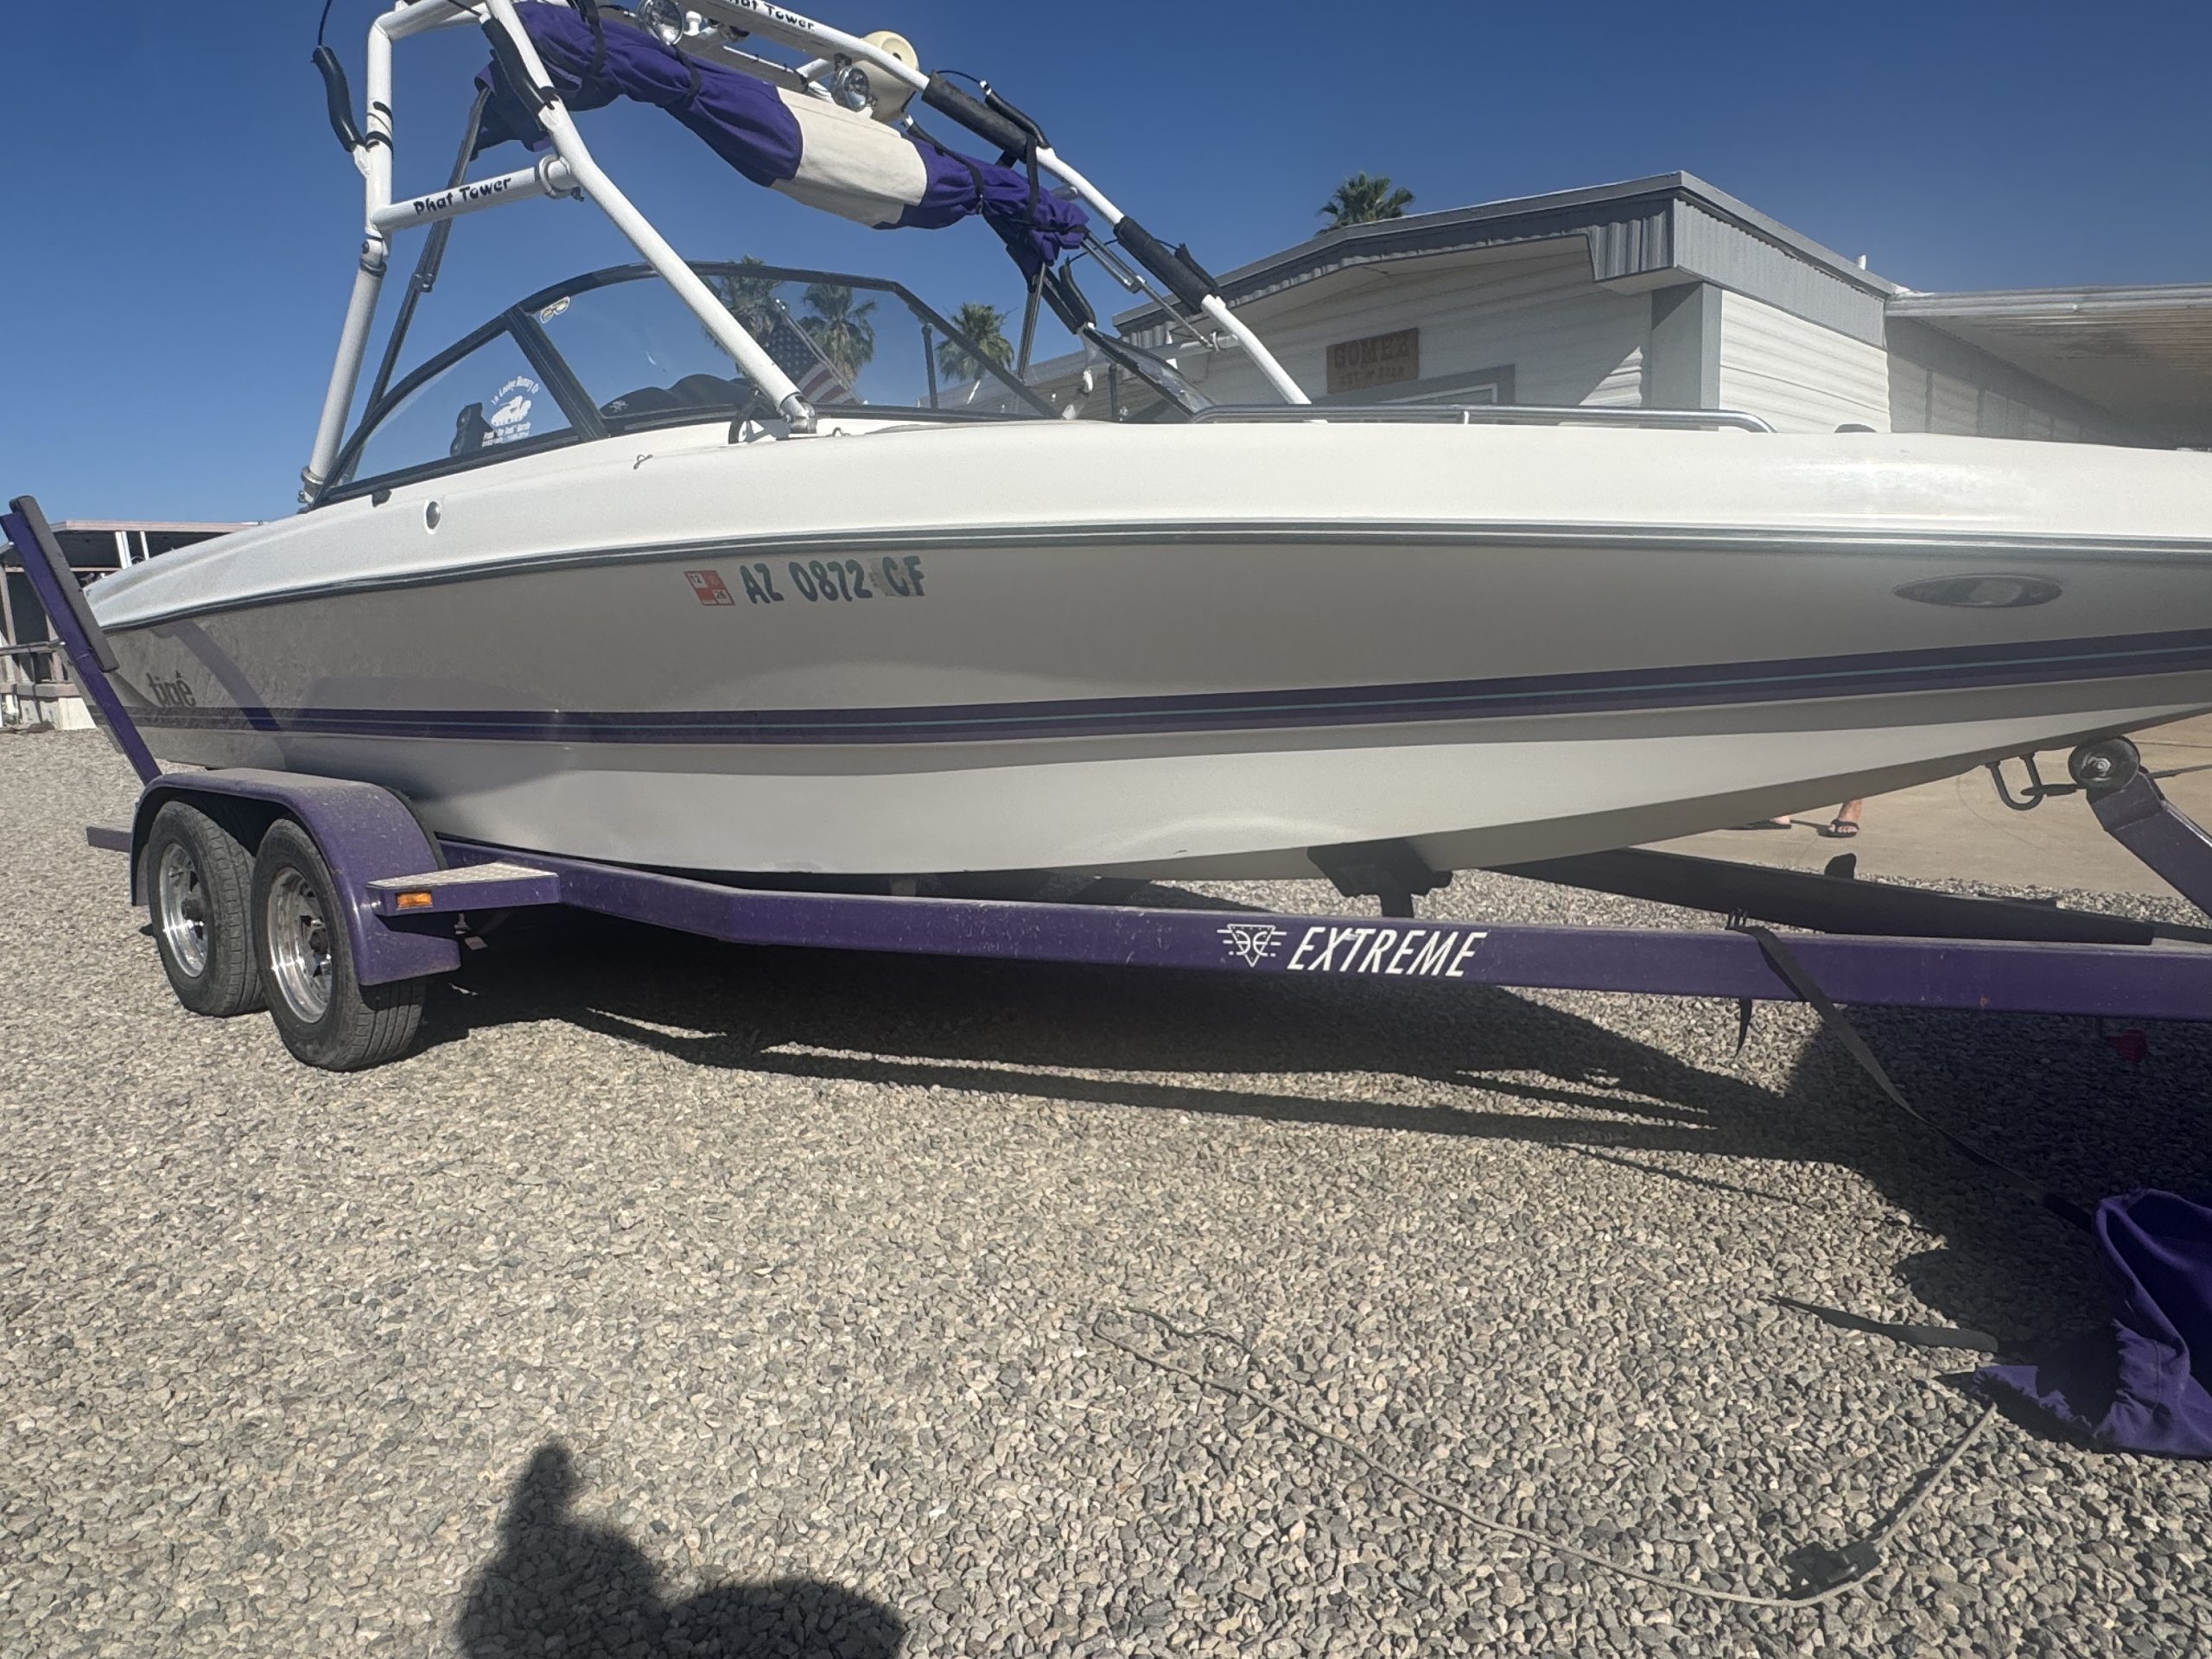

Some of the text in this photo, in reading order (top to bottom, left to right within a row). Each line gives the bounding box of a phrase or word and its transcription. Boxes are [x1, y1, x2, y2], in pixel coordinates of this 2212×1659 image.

[764, 3, 815, 29] Tower
[413, 177, 512, 215] Phat Tower
[690, 575, 702, 583] 12
[740, 555, 925, 604] AZ 0872 CF
[1287, 926, 1488, 977] EXTREME
